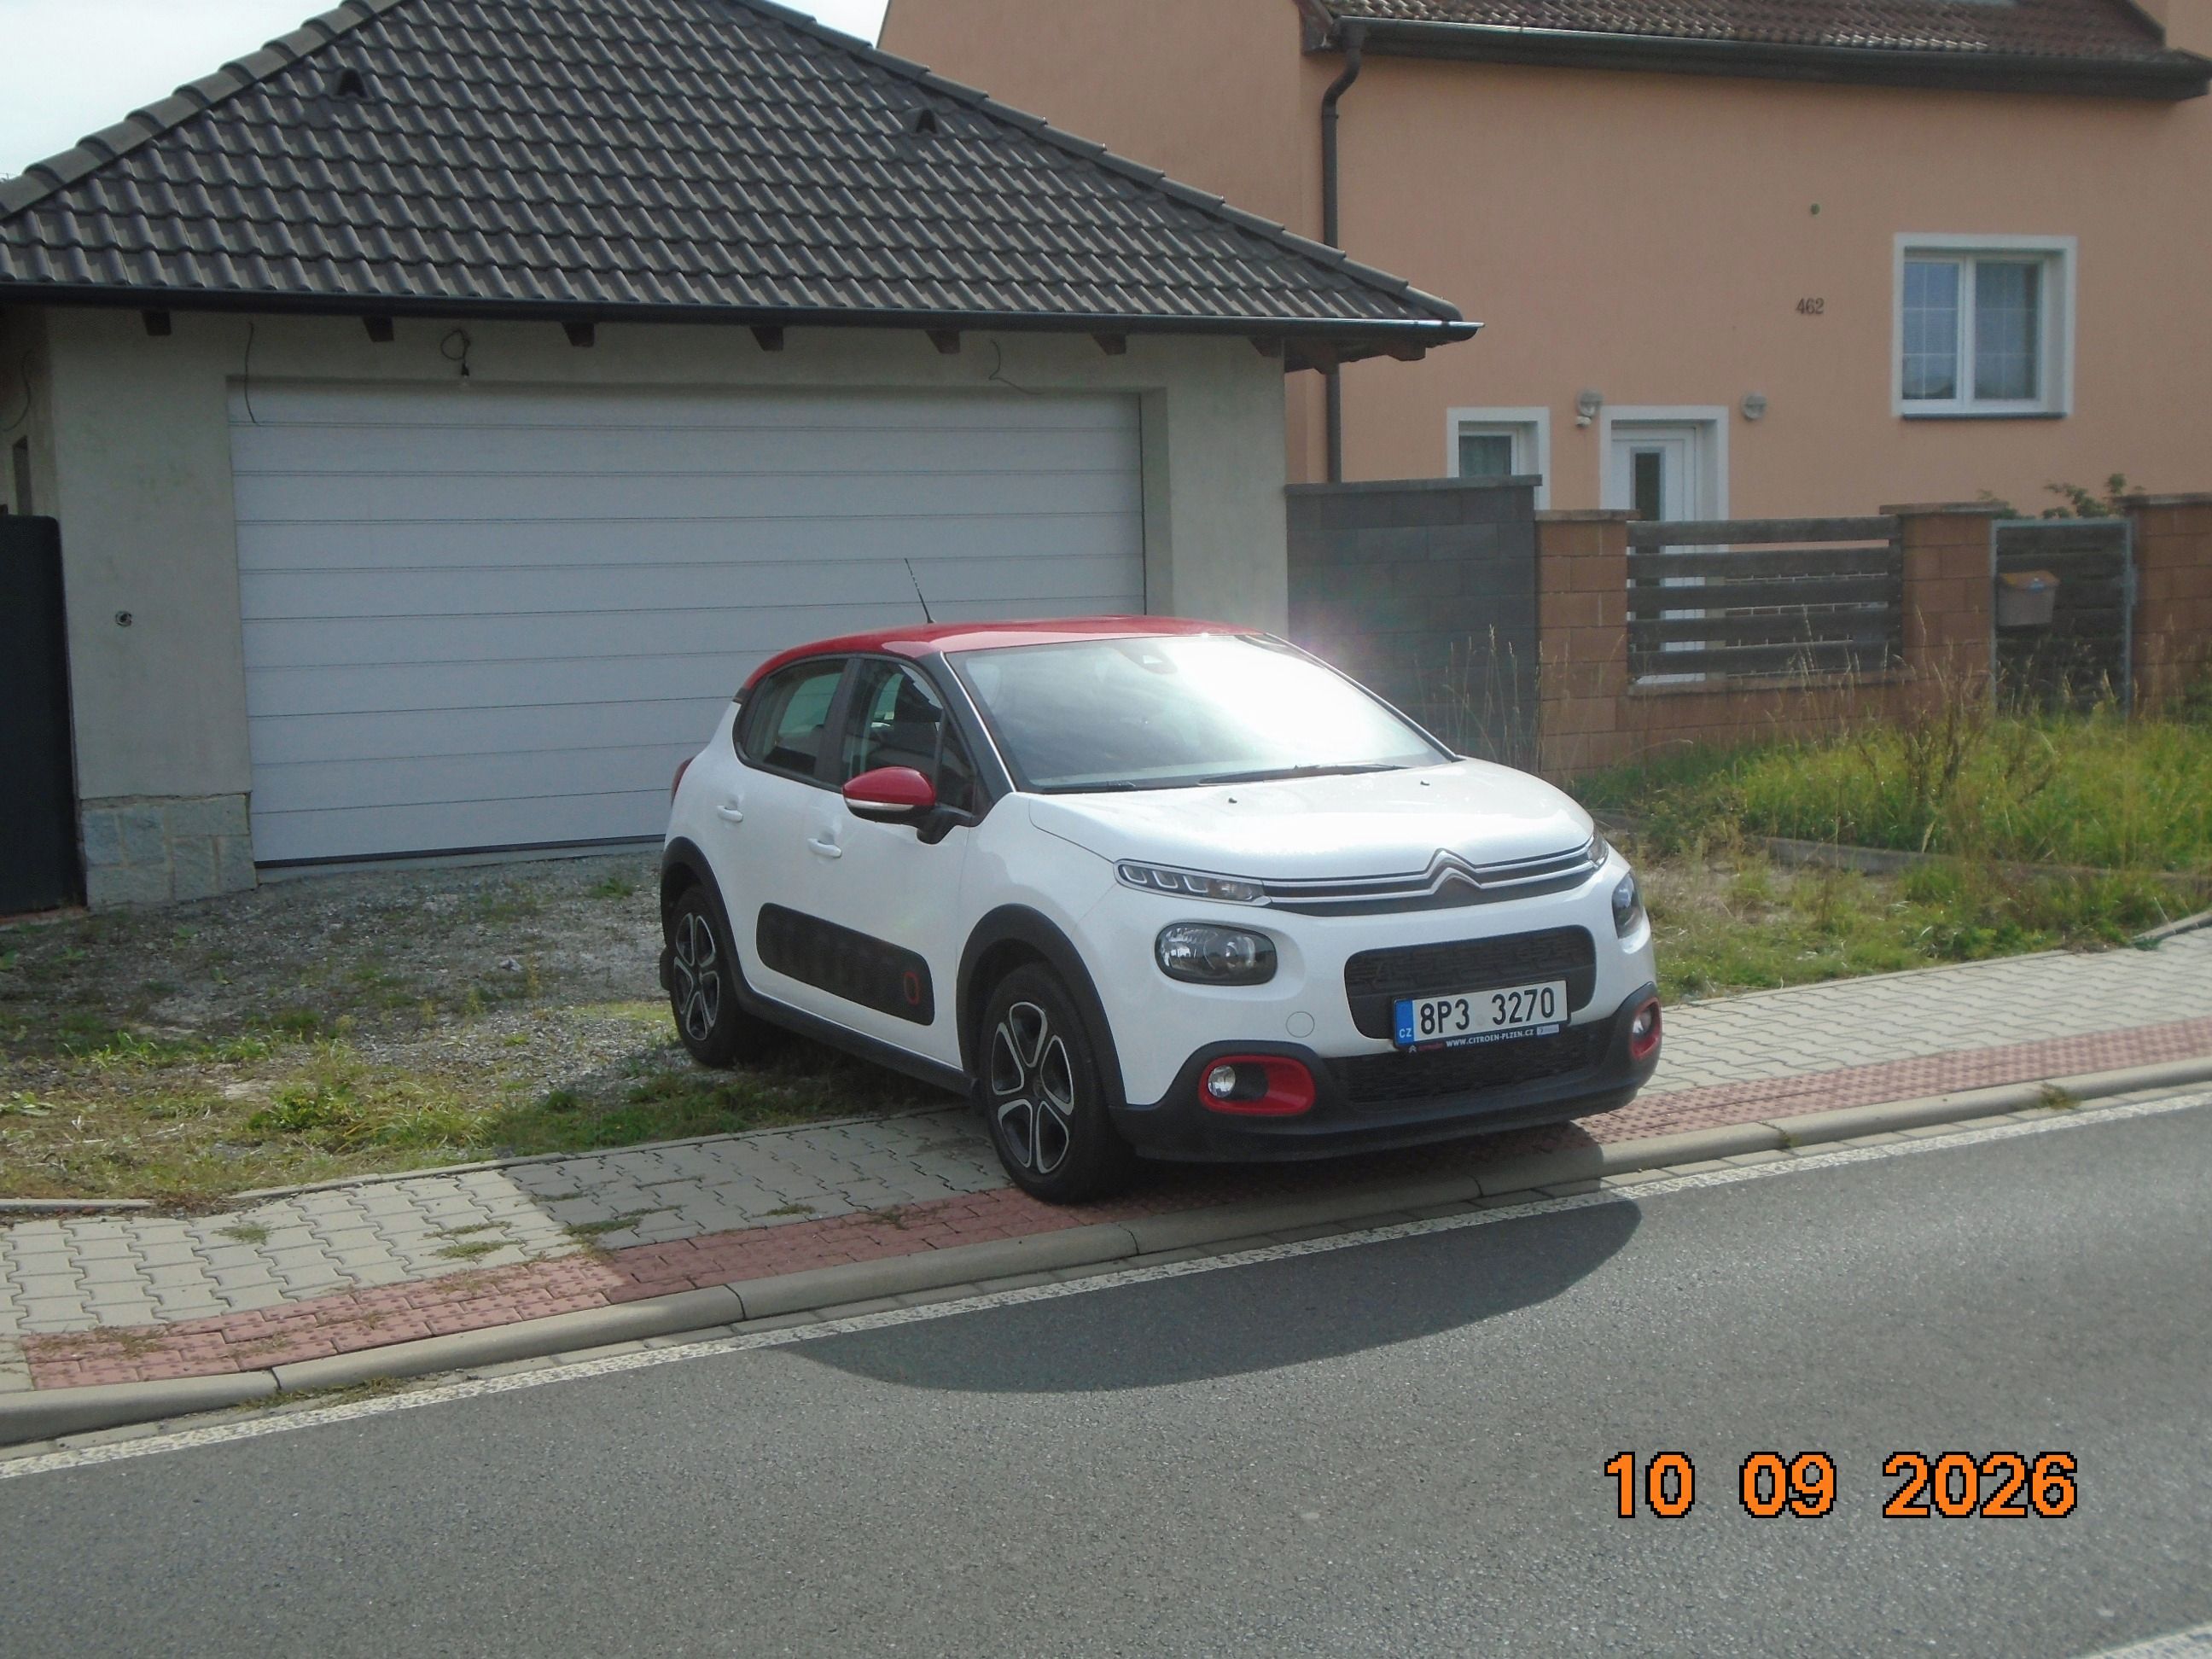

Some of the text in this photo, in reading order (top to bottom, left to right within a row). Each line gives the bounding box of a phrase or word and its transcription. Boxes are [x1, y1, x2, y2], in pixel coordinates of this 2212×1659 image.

[1795, 297, 1825, 315] 462
[1420, 987, 1555, 1035] 8P3 3270
[1399, 1027, 1412, 1039] CZ
